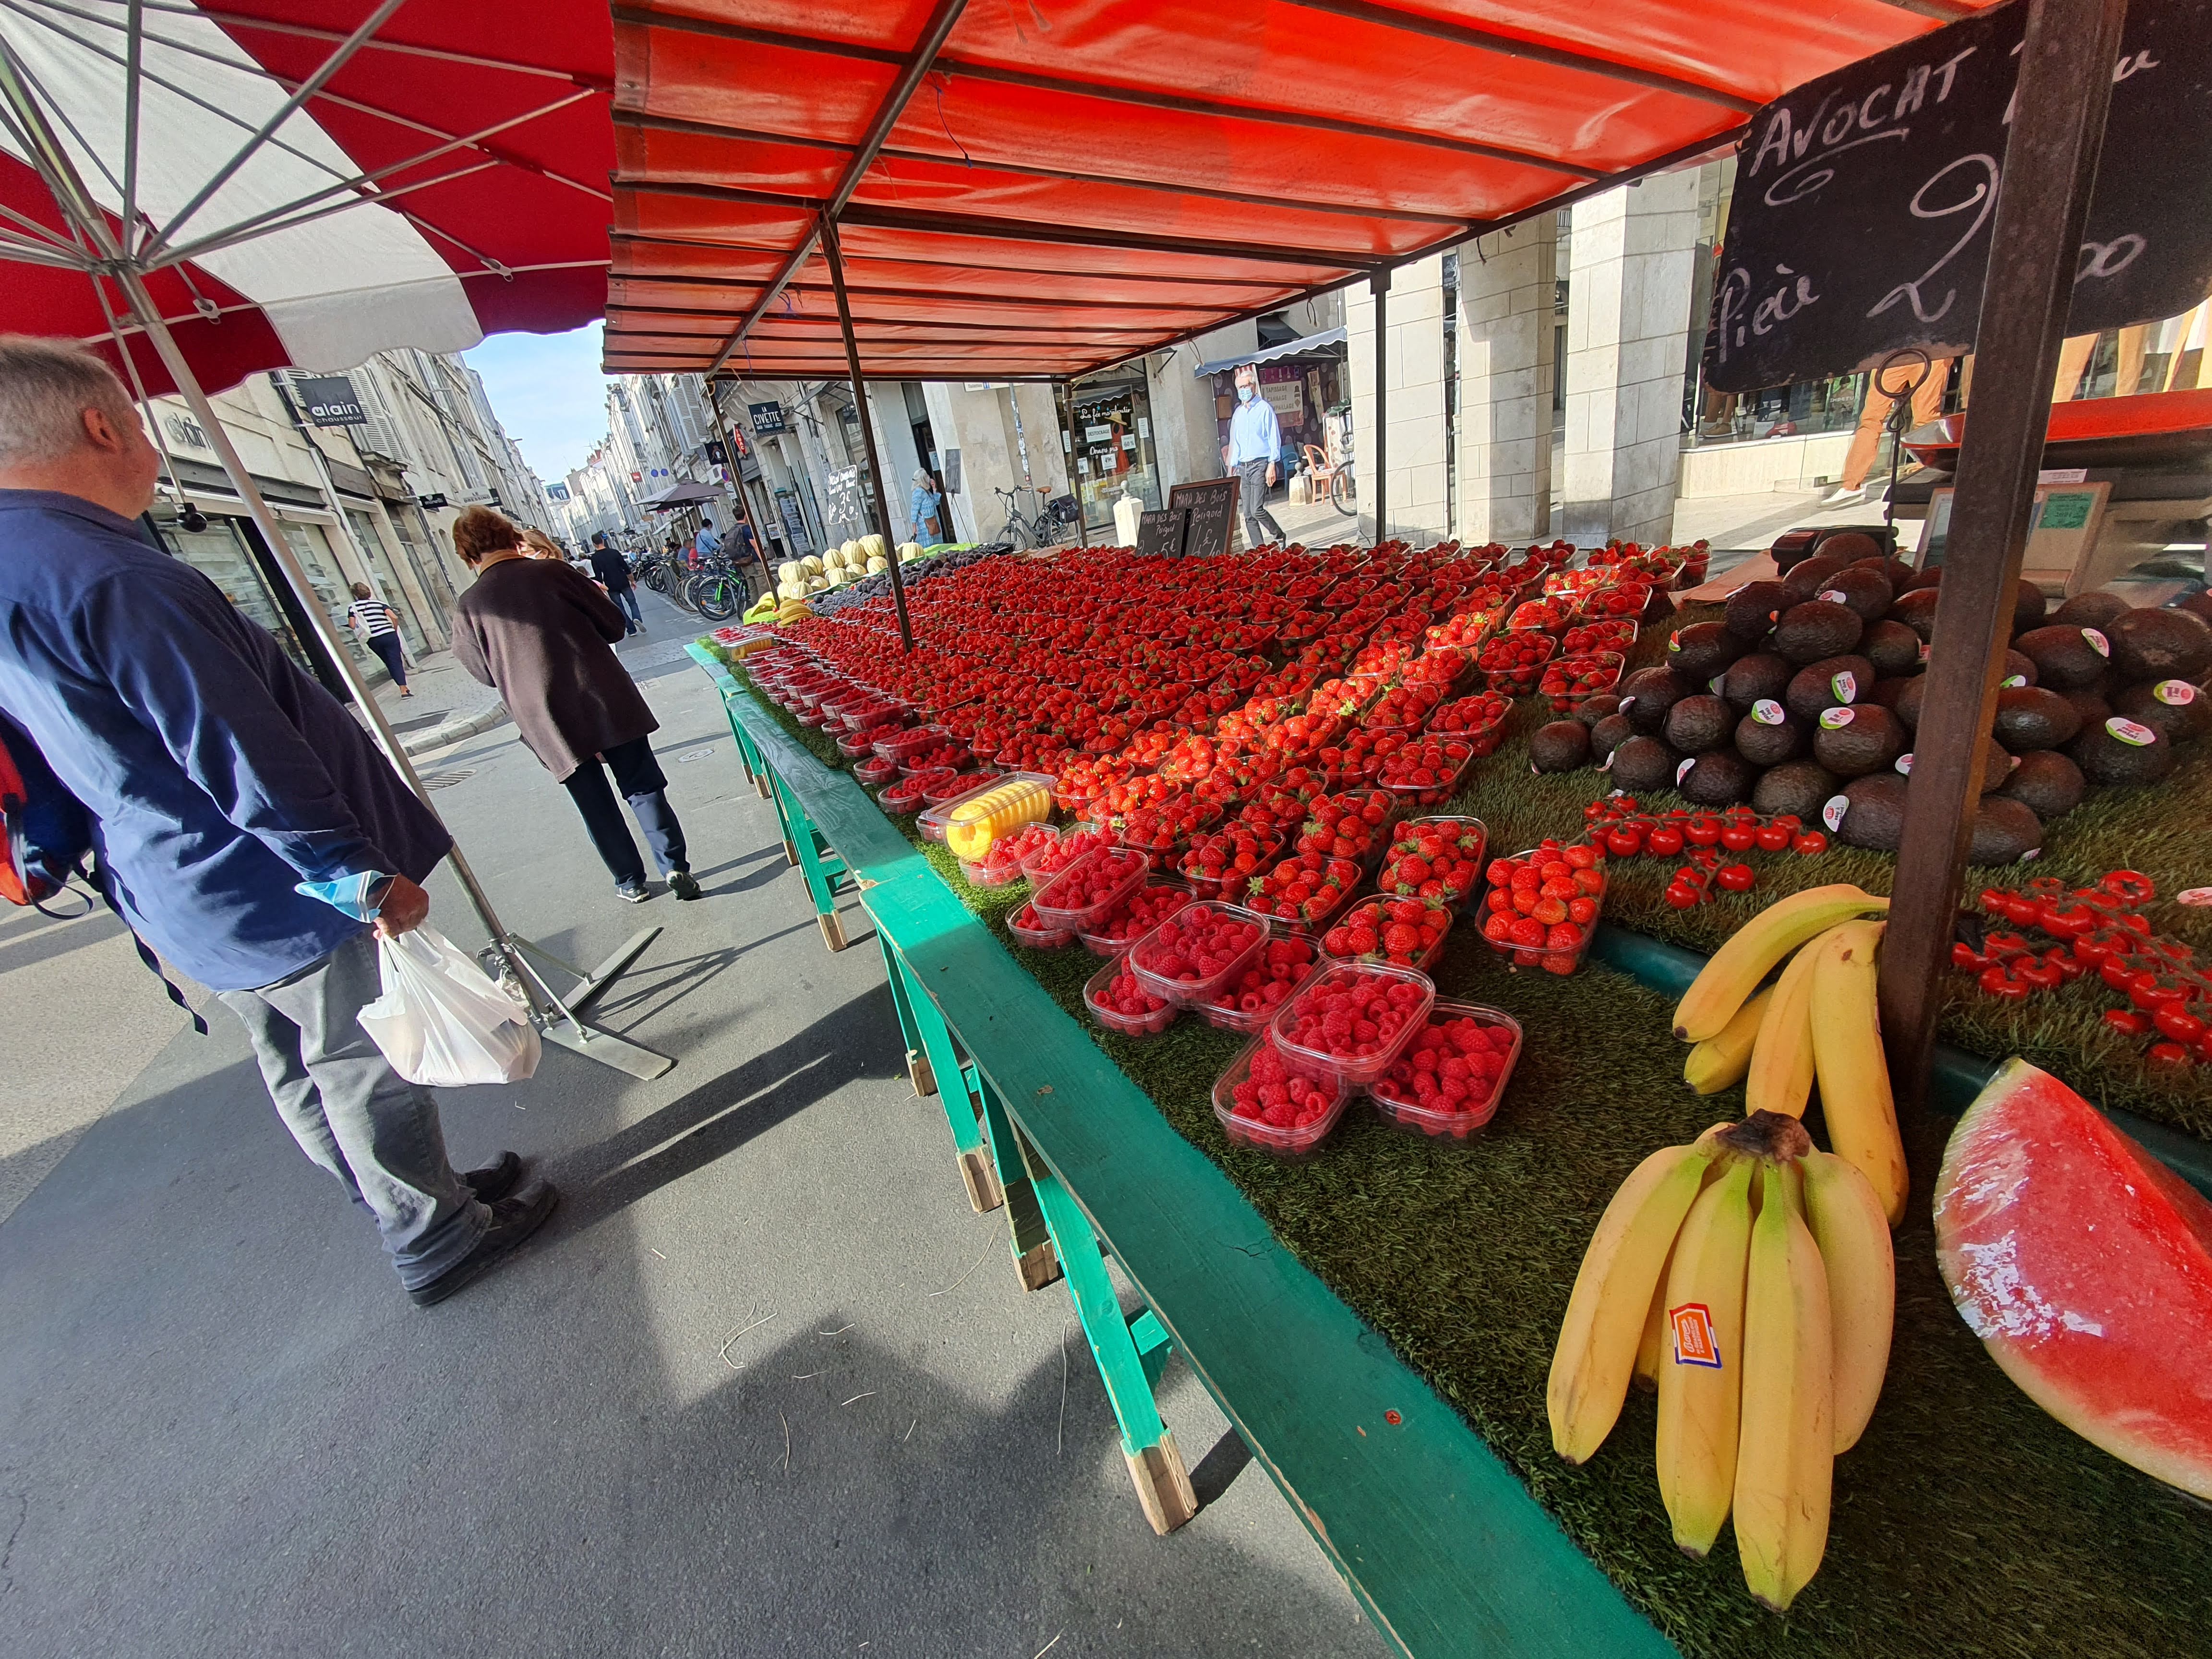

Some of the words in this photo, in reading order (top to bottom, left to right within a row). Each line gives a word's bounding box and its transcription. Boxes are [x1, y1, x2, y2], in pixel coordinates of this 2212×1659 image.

[1749, 47, 1977, 178] AVOCAT
[1866, 153, 1998, 323] 2
[312, 401, 361, 417] alain
[1080, 409, 1092, 419] La
[1092, 408, 1101, 423] fée
[753, 411, 781, 425] CIVETTE
[735, 429, 745, 450] TABAC
[463, 495, 491, 503] DRESSING
[1176, 492, 1192, 508] MARA
[1194, 491, 1207, 505] DES
[1142, 514, 1155, 525] MARA
[1156, 513, 1167, 524] DES
